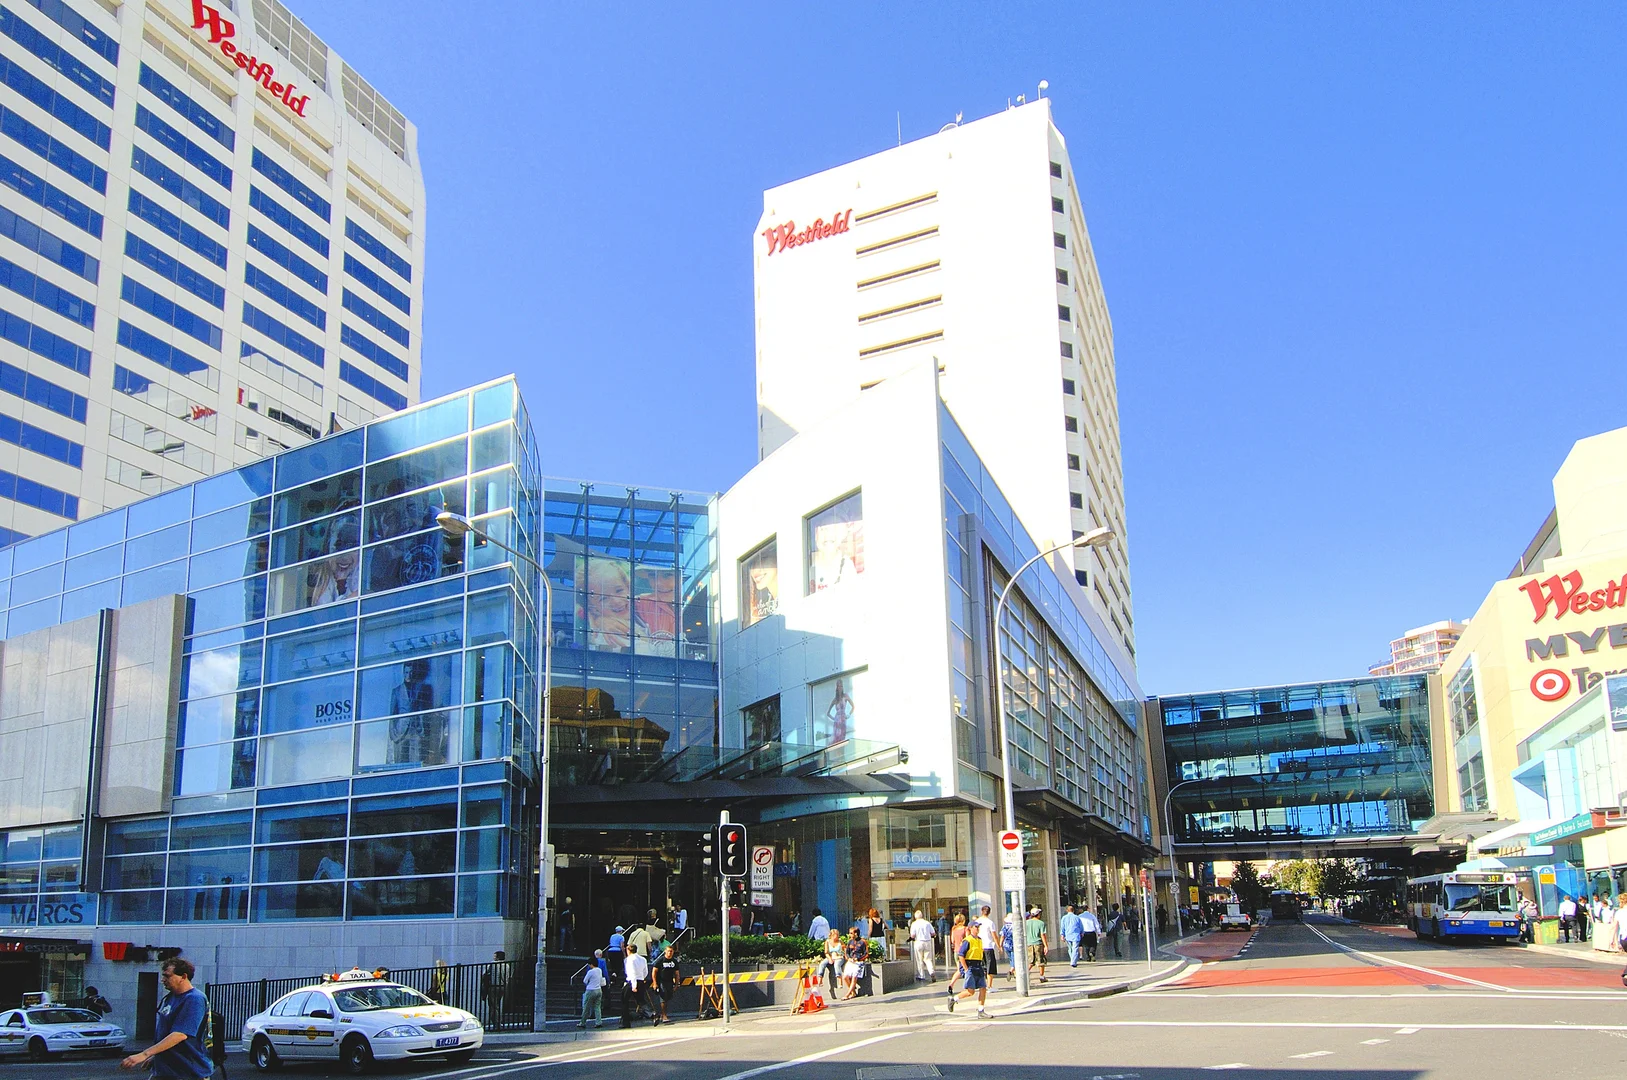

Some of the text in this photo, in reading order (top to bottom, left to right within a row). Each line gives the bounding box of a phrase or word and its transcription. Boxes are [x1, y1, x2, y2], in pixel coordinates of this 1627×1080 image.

[190, 0, 311, 117] Westfield
[761, 208, 852, 256] Westfield
[315, 699, 352, 718] BOSS
[10, 903, 84, 924] MARCS
